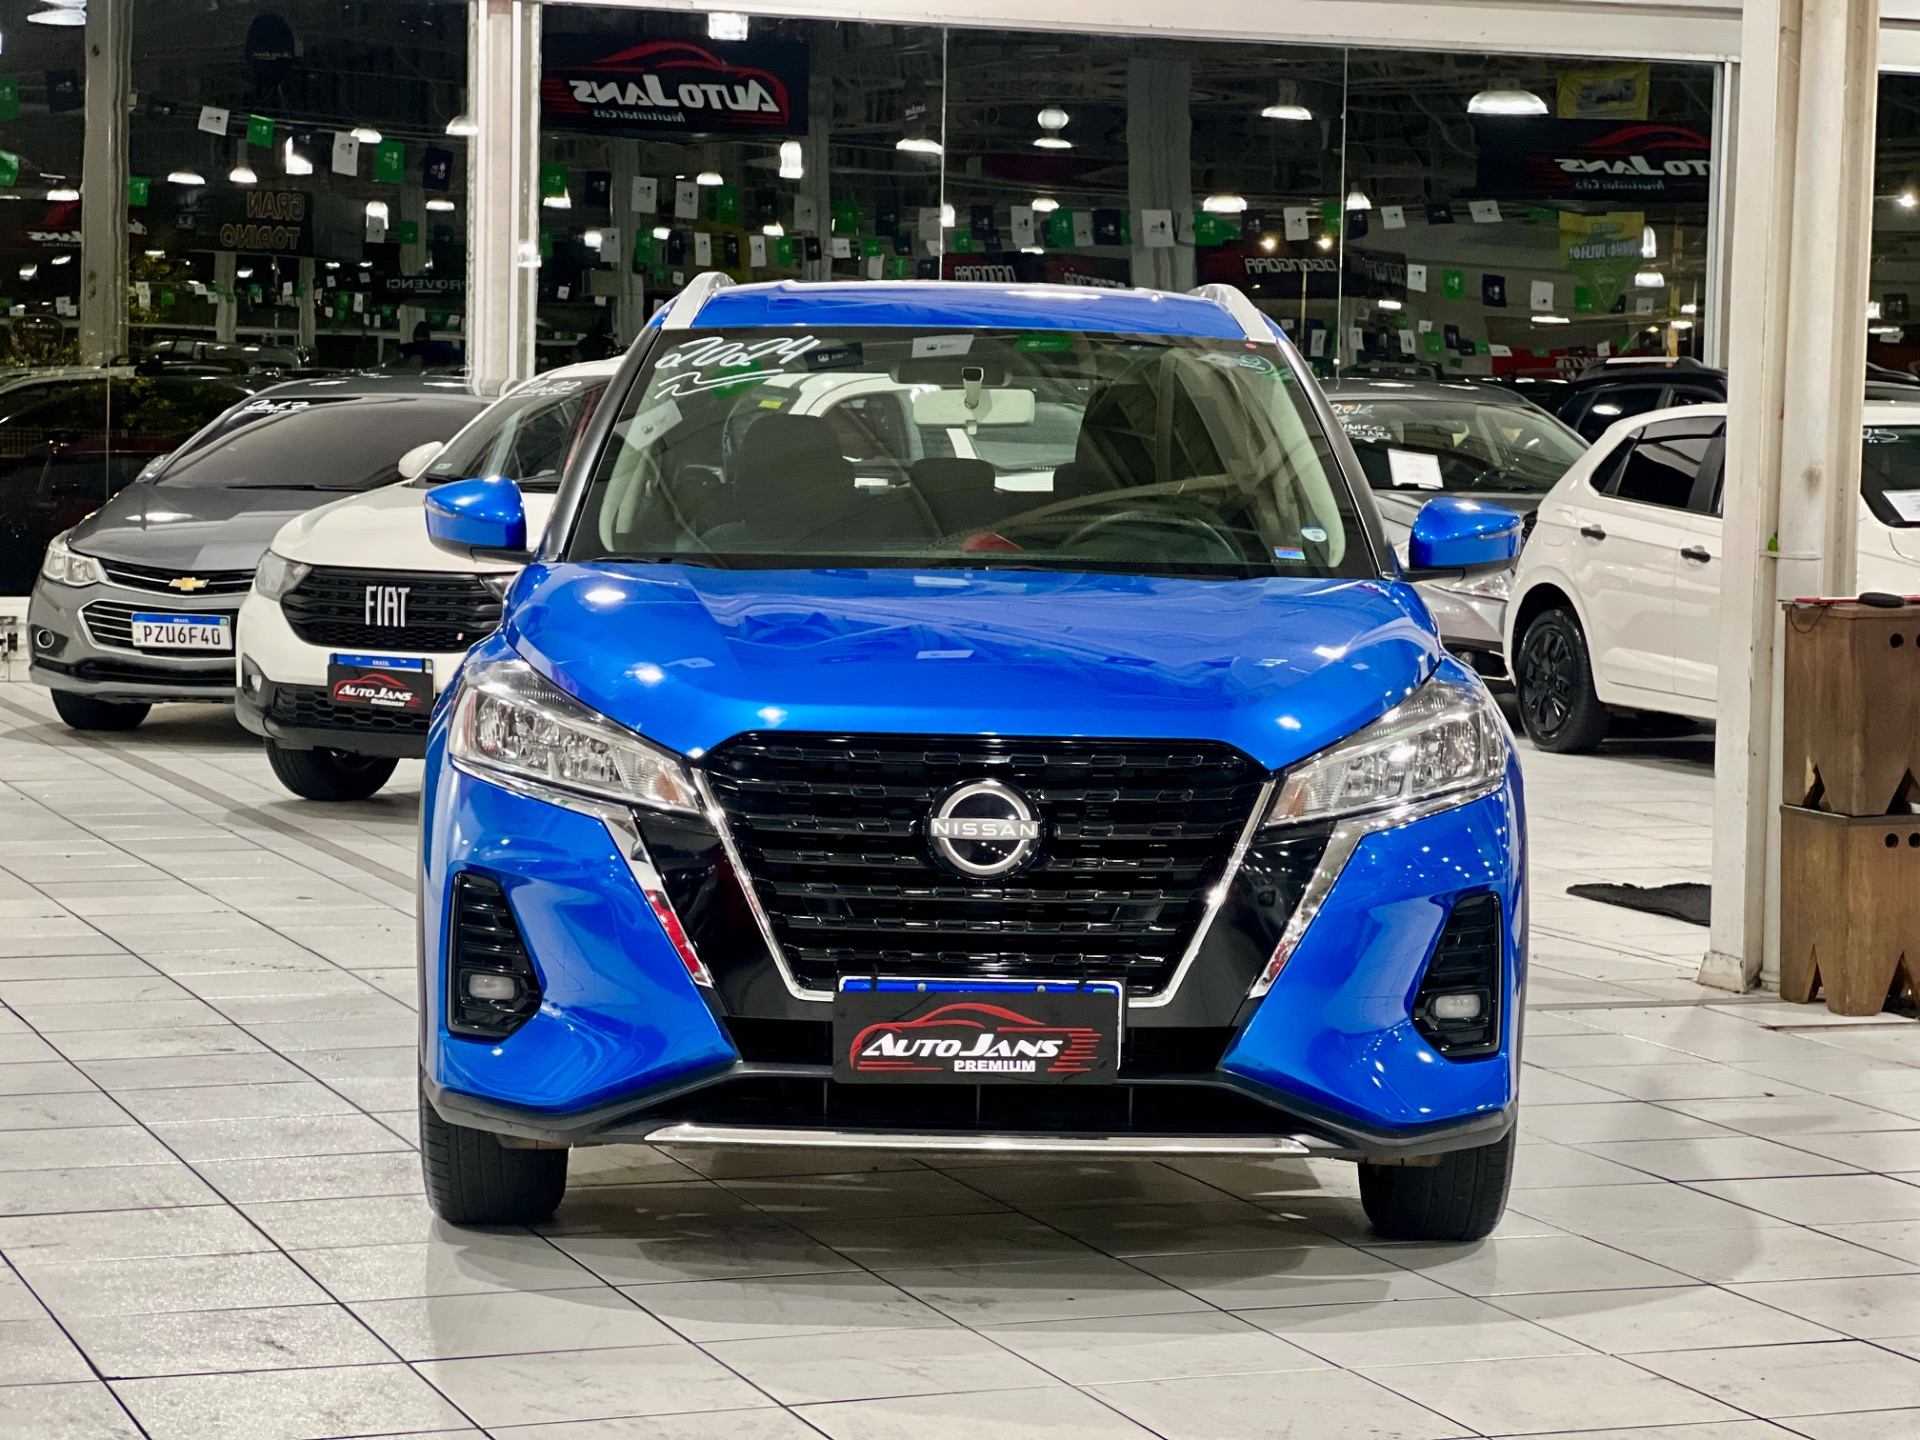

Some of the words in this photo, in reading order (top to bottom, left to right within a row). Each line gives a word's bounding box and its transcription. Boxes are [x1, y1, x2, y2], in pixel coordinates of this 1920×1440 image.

[653, 334, 821, 369] 2024
[364, 584, 411, 628] FIAT
[143, 625, 222, 645] PZU6F40
[932, 820, 1038, 839] NISSAN
[953, 1059, 1036, 1073] PREMIUM
